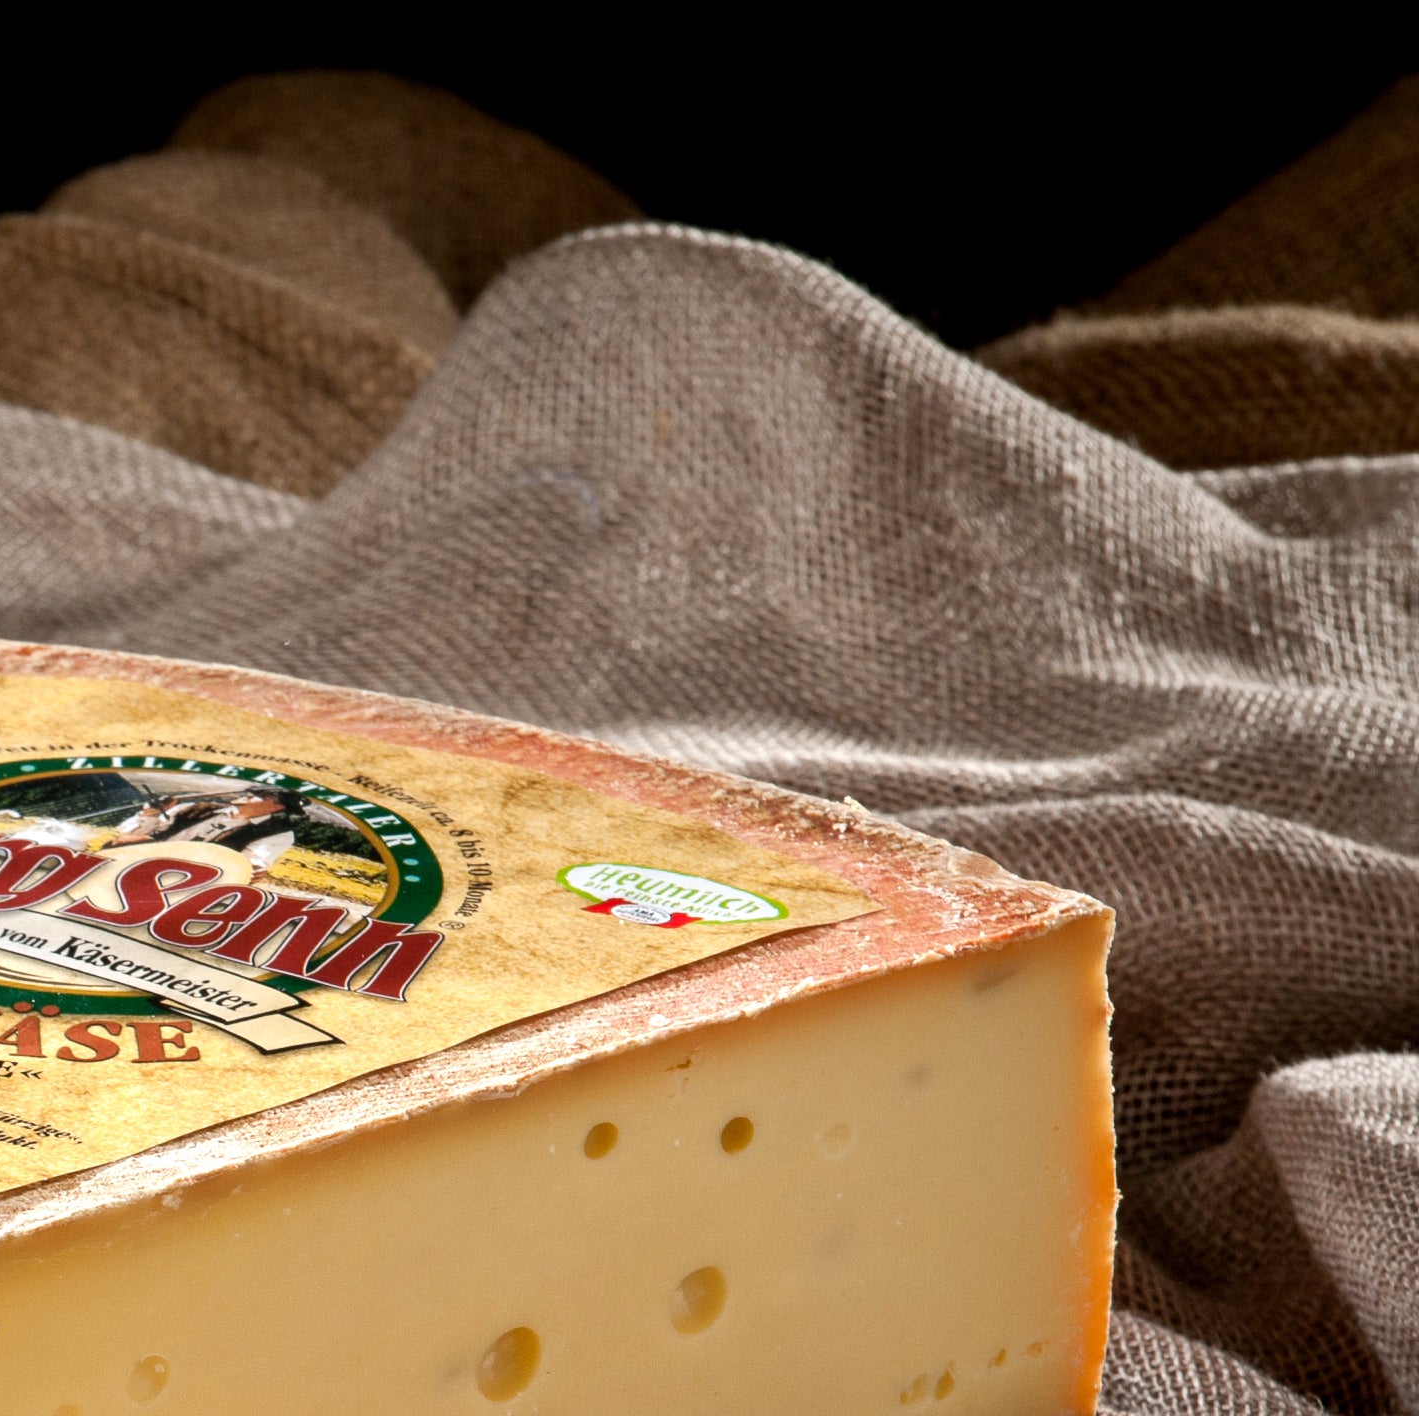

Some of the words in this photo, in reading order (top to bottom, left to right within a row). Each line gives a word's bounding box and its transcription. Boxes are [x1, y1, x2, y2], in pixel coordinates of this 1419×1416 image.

[67, 755, 418, 848] ZILLERTALER
[450, 828, 475, 837] 8
[457, 839, 487, 860] bis
[467, 861, 493, 877] 10
[455, 879, 493, 918] Monate
[589, 865, 761, 914] Heumilch
[52, 934, 258, 1013] Käsermeister
